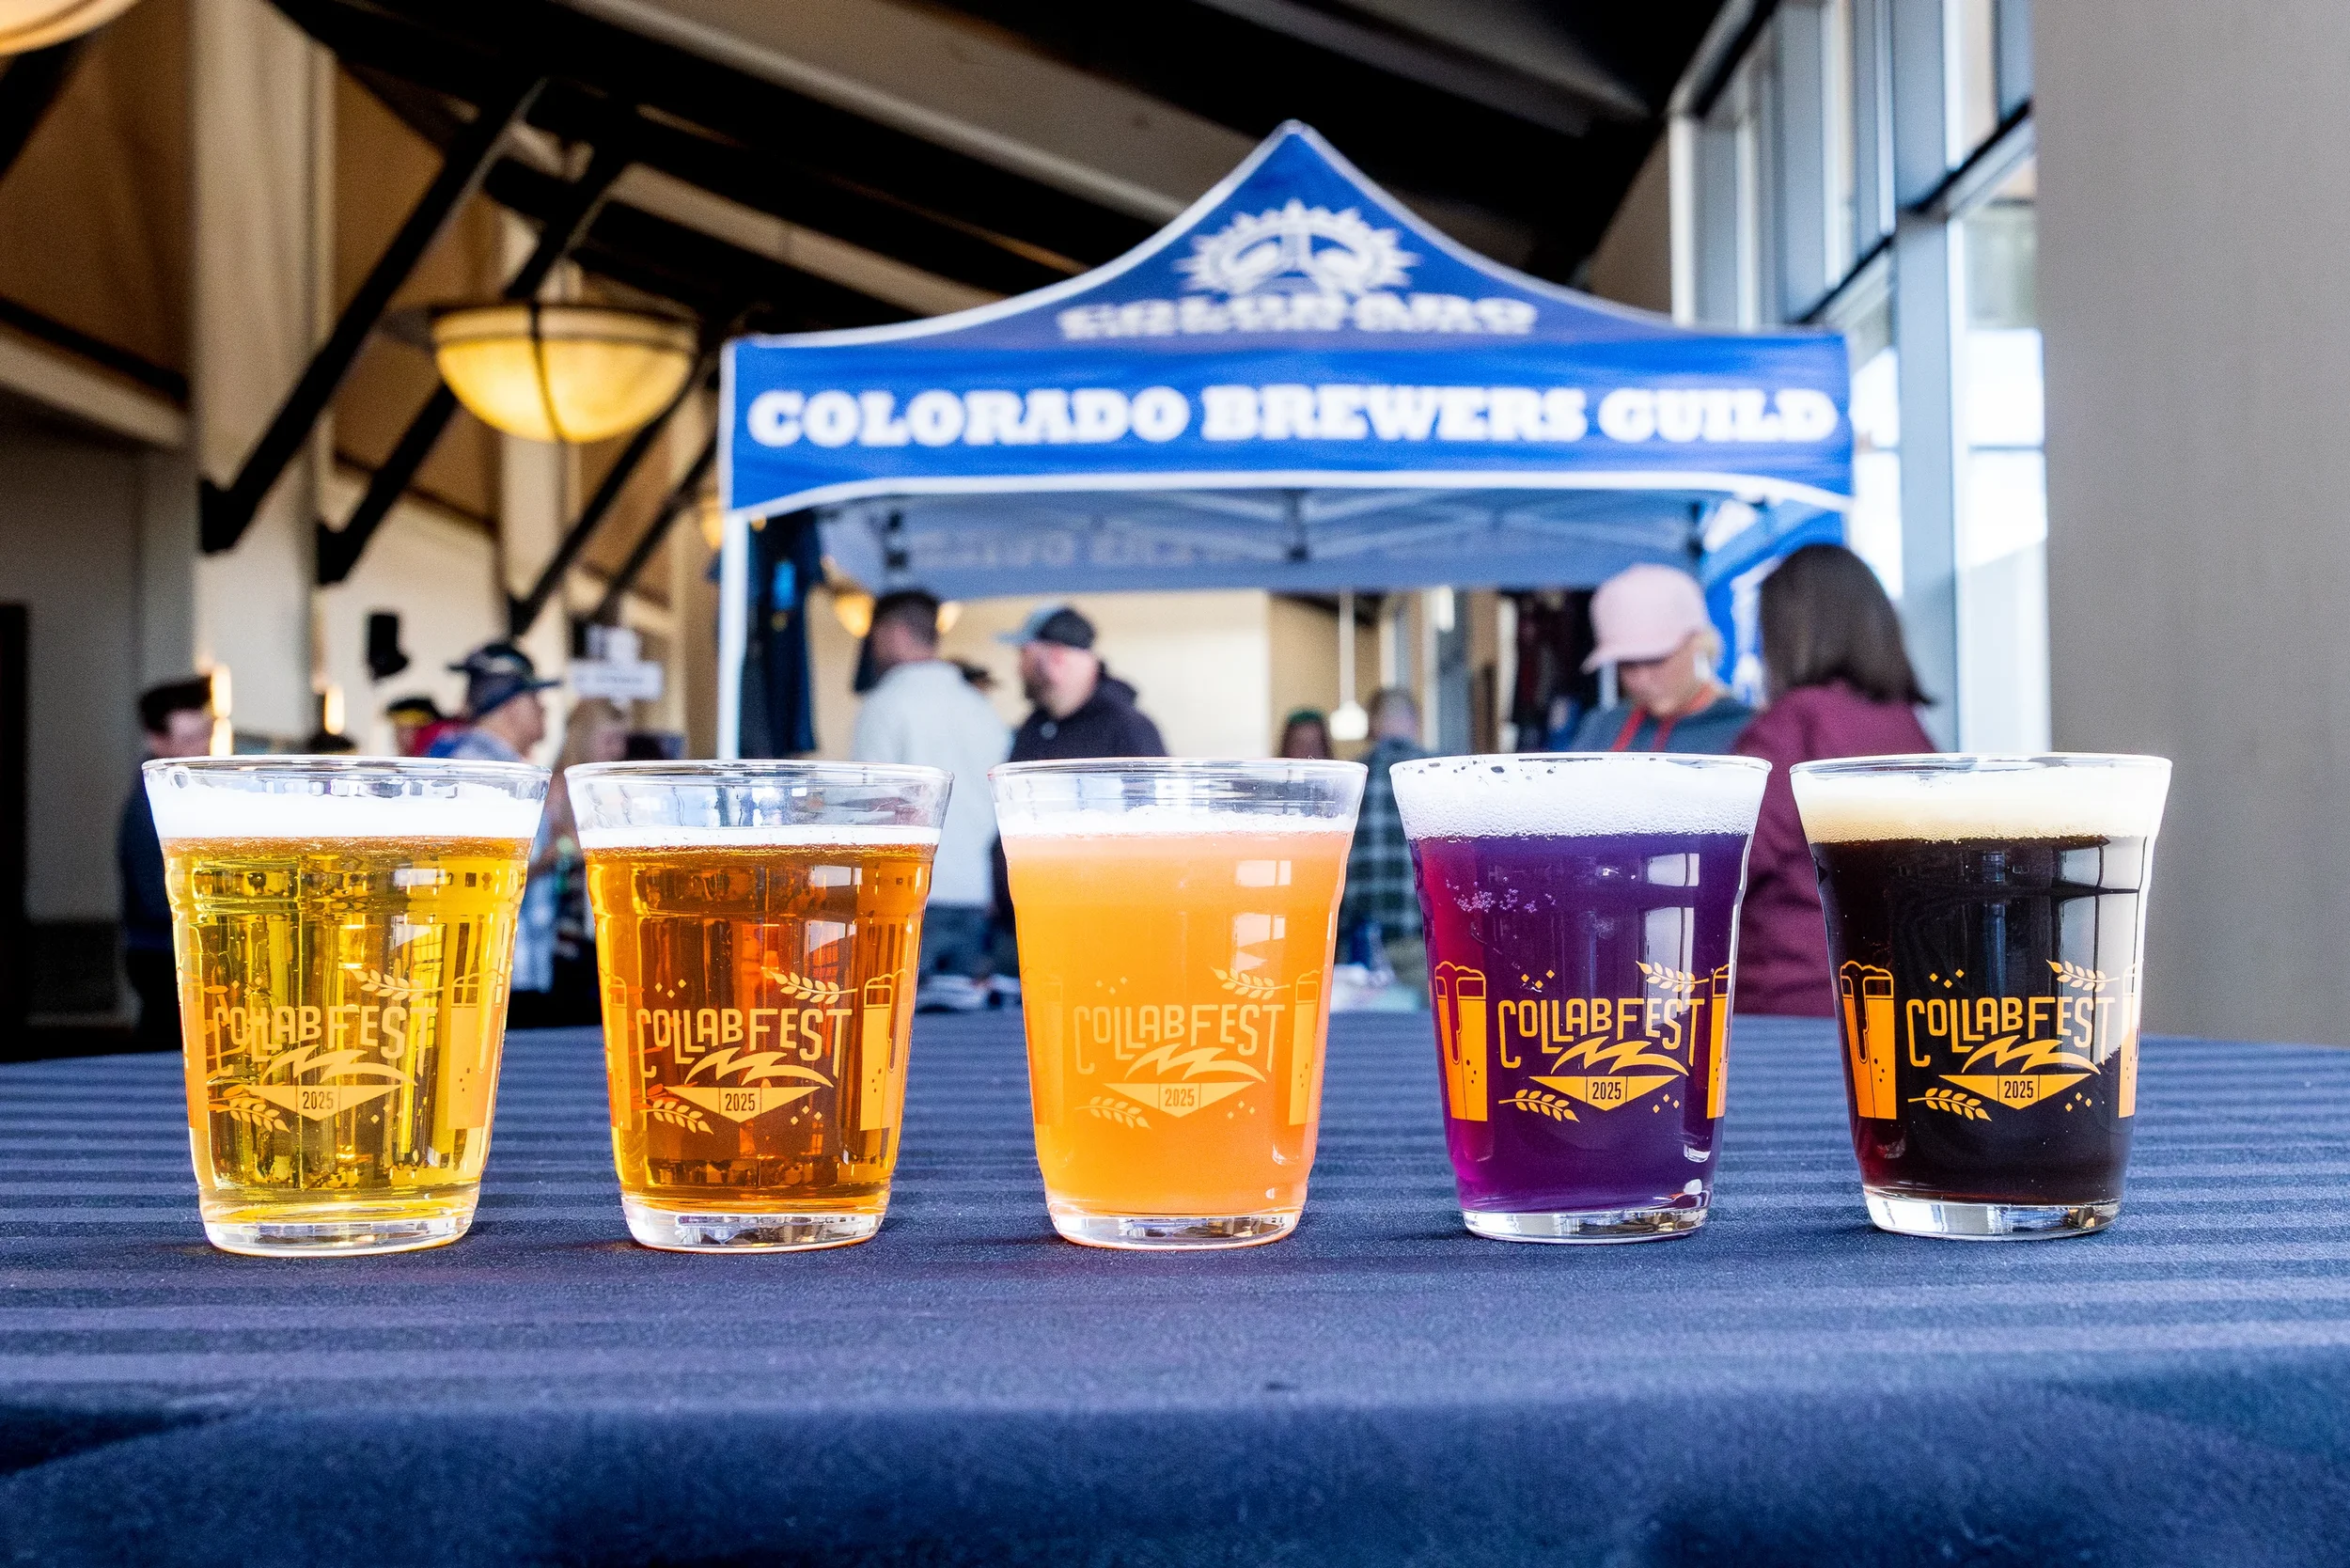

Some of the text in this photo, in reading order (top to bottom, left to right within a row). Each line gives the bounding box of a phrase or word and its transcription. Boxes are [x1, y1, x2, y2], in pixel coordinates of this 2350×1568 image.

[749, 384, 1838, 447] COLORADO BREWERS GUILD
[636, 1008, 853, 1078] COLLABFEST
[1073, 1004, 1285, 1074] COLLABFEST
[1497, 997, 1705, 1069] COLLABFEST
[1905, 996, 2115, 1067] COLLABFEST
[302, 1090, 335, 1110] 2025
[725, 1092, 756, 1112] 2025
[1165, 1088, 1195, 1107] 2025
[1591, 1081, 1622, 1100] 2025
[2003, 1080, 2033, 1099] 2025
